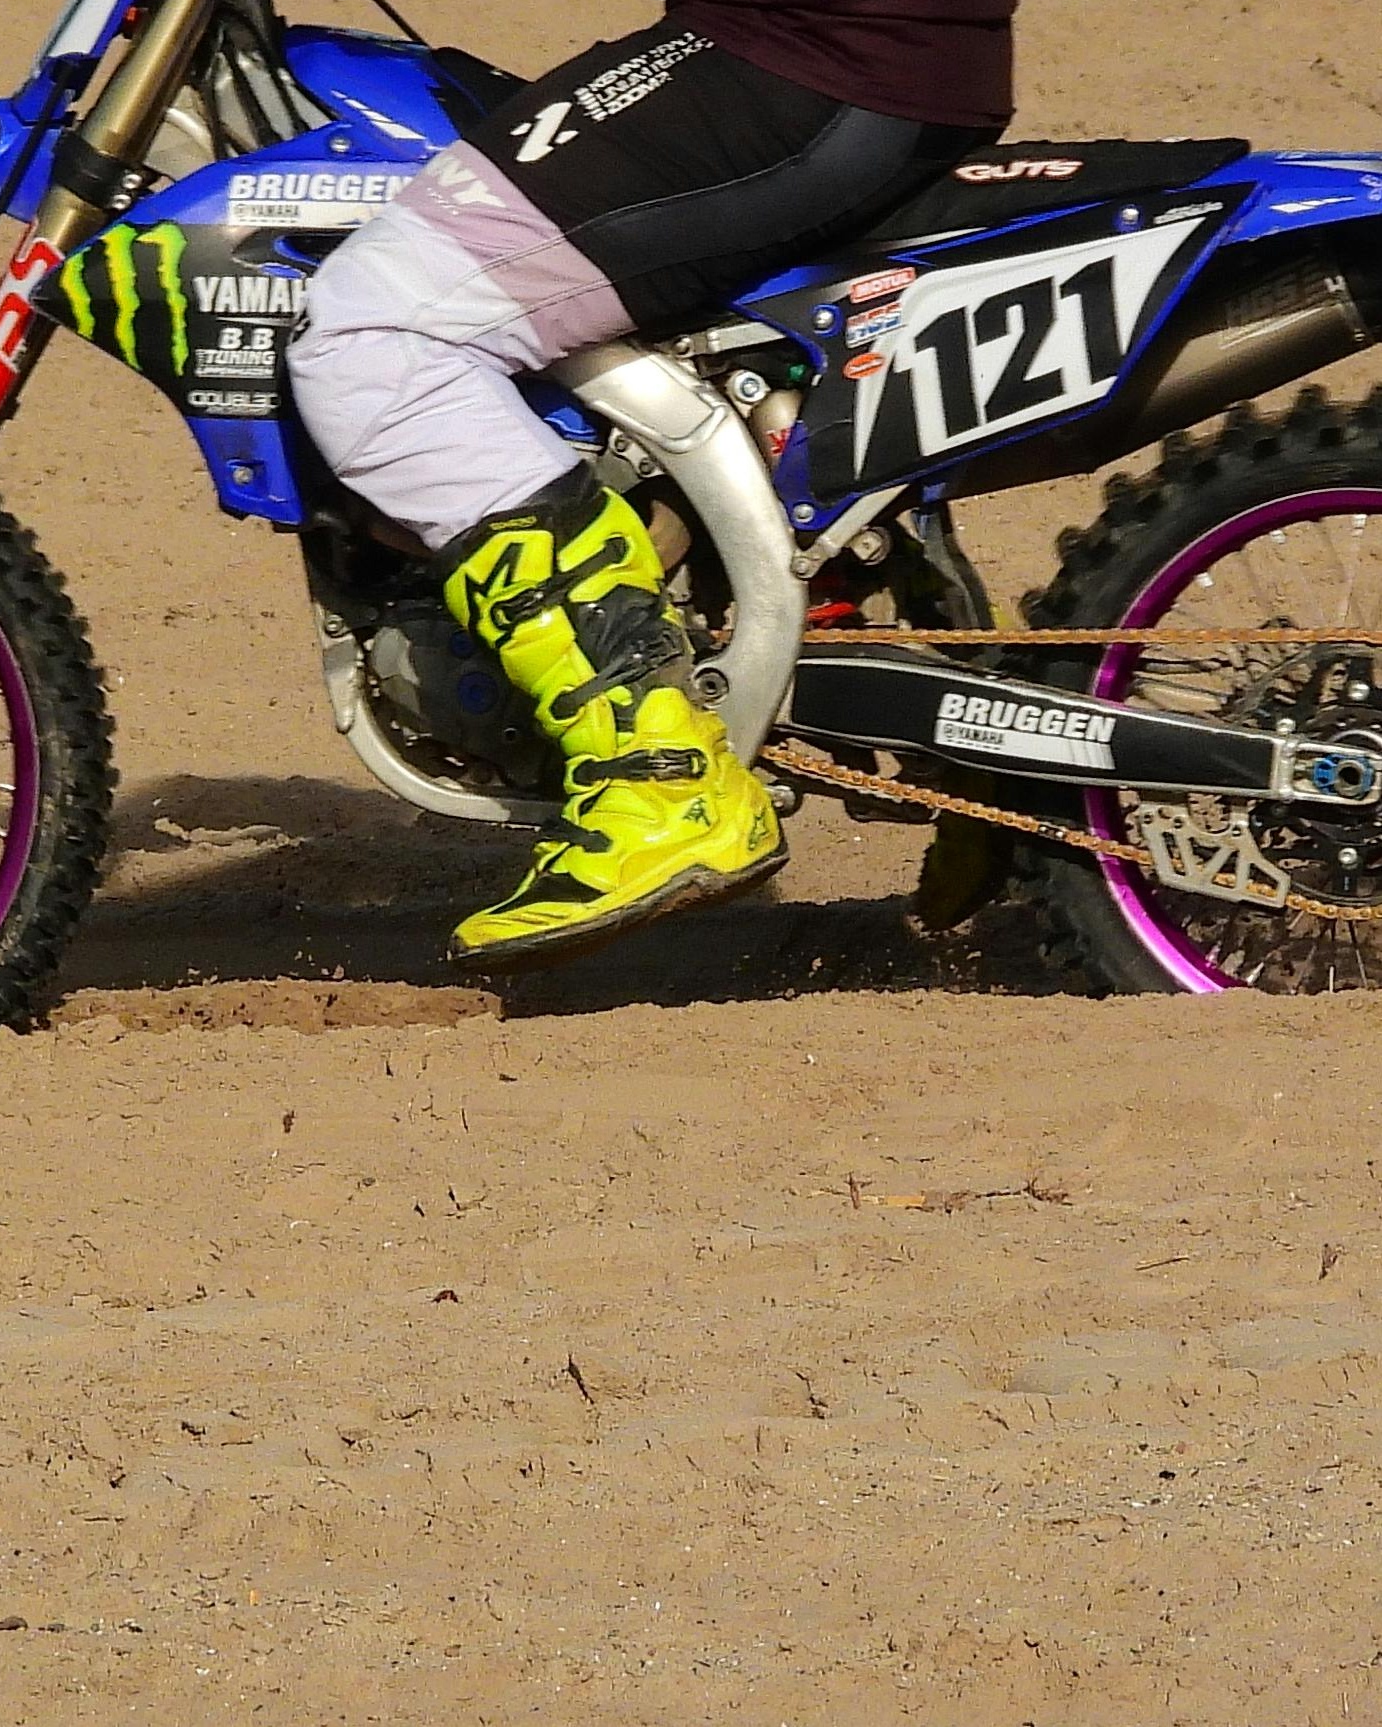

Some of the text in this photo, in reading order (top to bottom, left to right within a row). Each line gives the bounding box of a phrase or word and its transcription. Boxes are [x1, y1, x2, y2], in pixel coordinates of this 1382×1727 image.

[956, 159, 1082, 180] GUTS
[853, 270, 912, 298] MOTUL
[914, 255, 1120, 440] 121
[938, 693, 1116, 743] BRUGGEN
